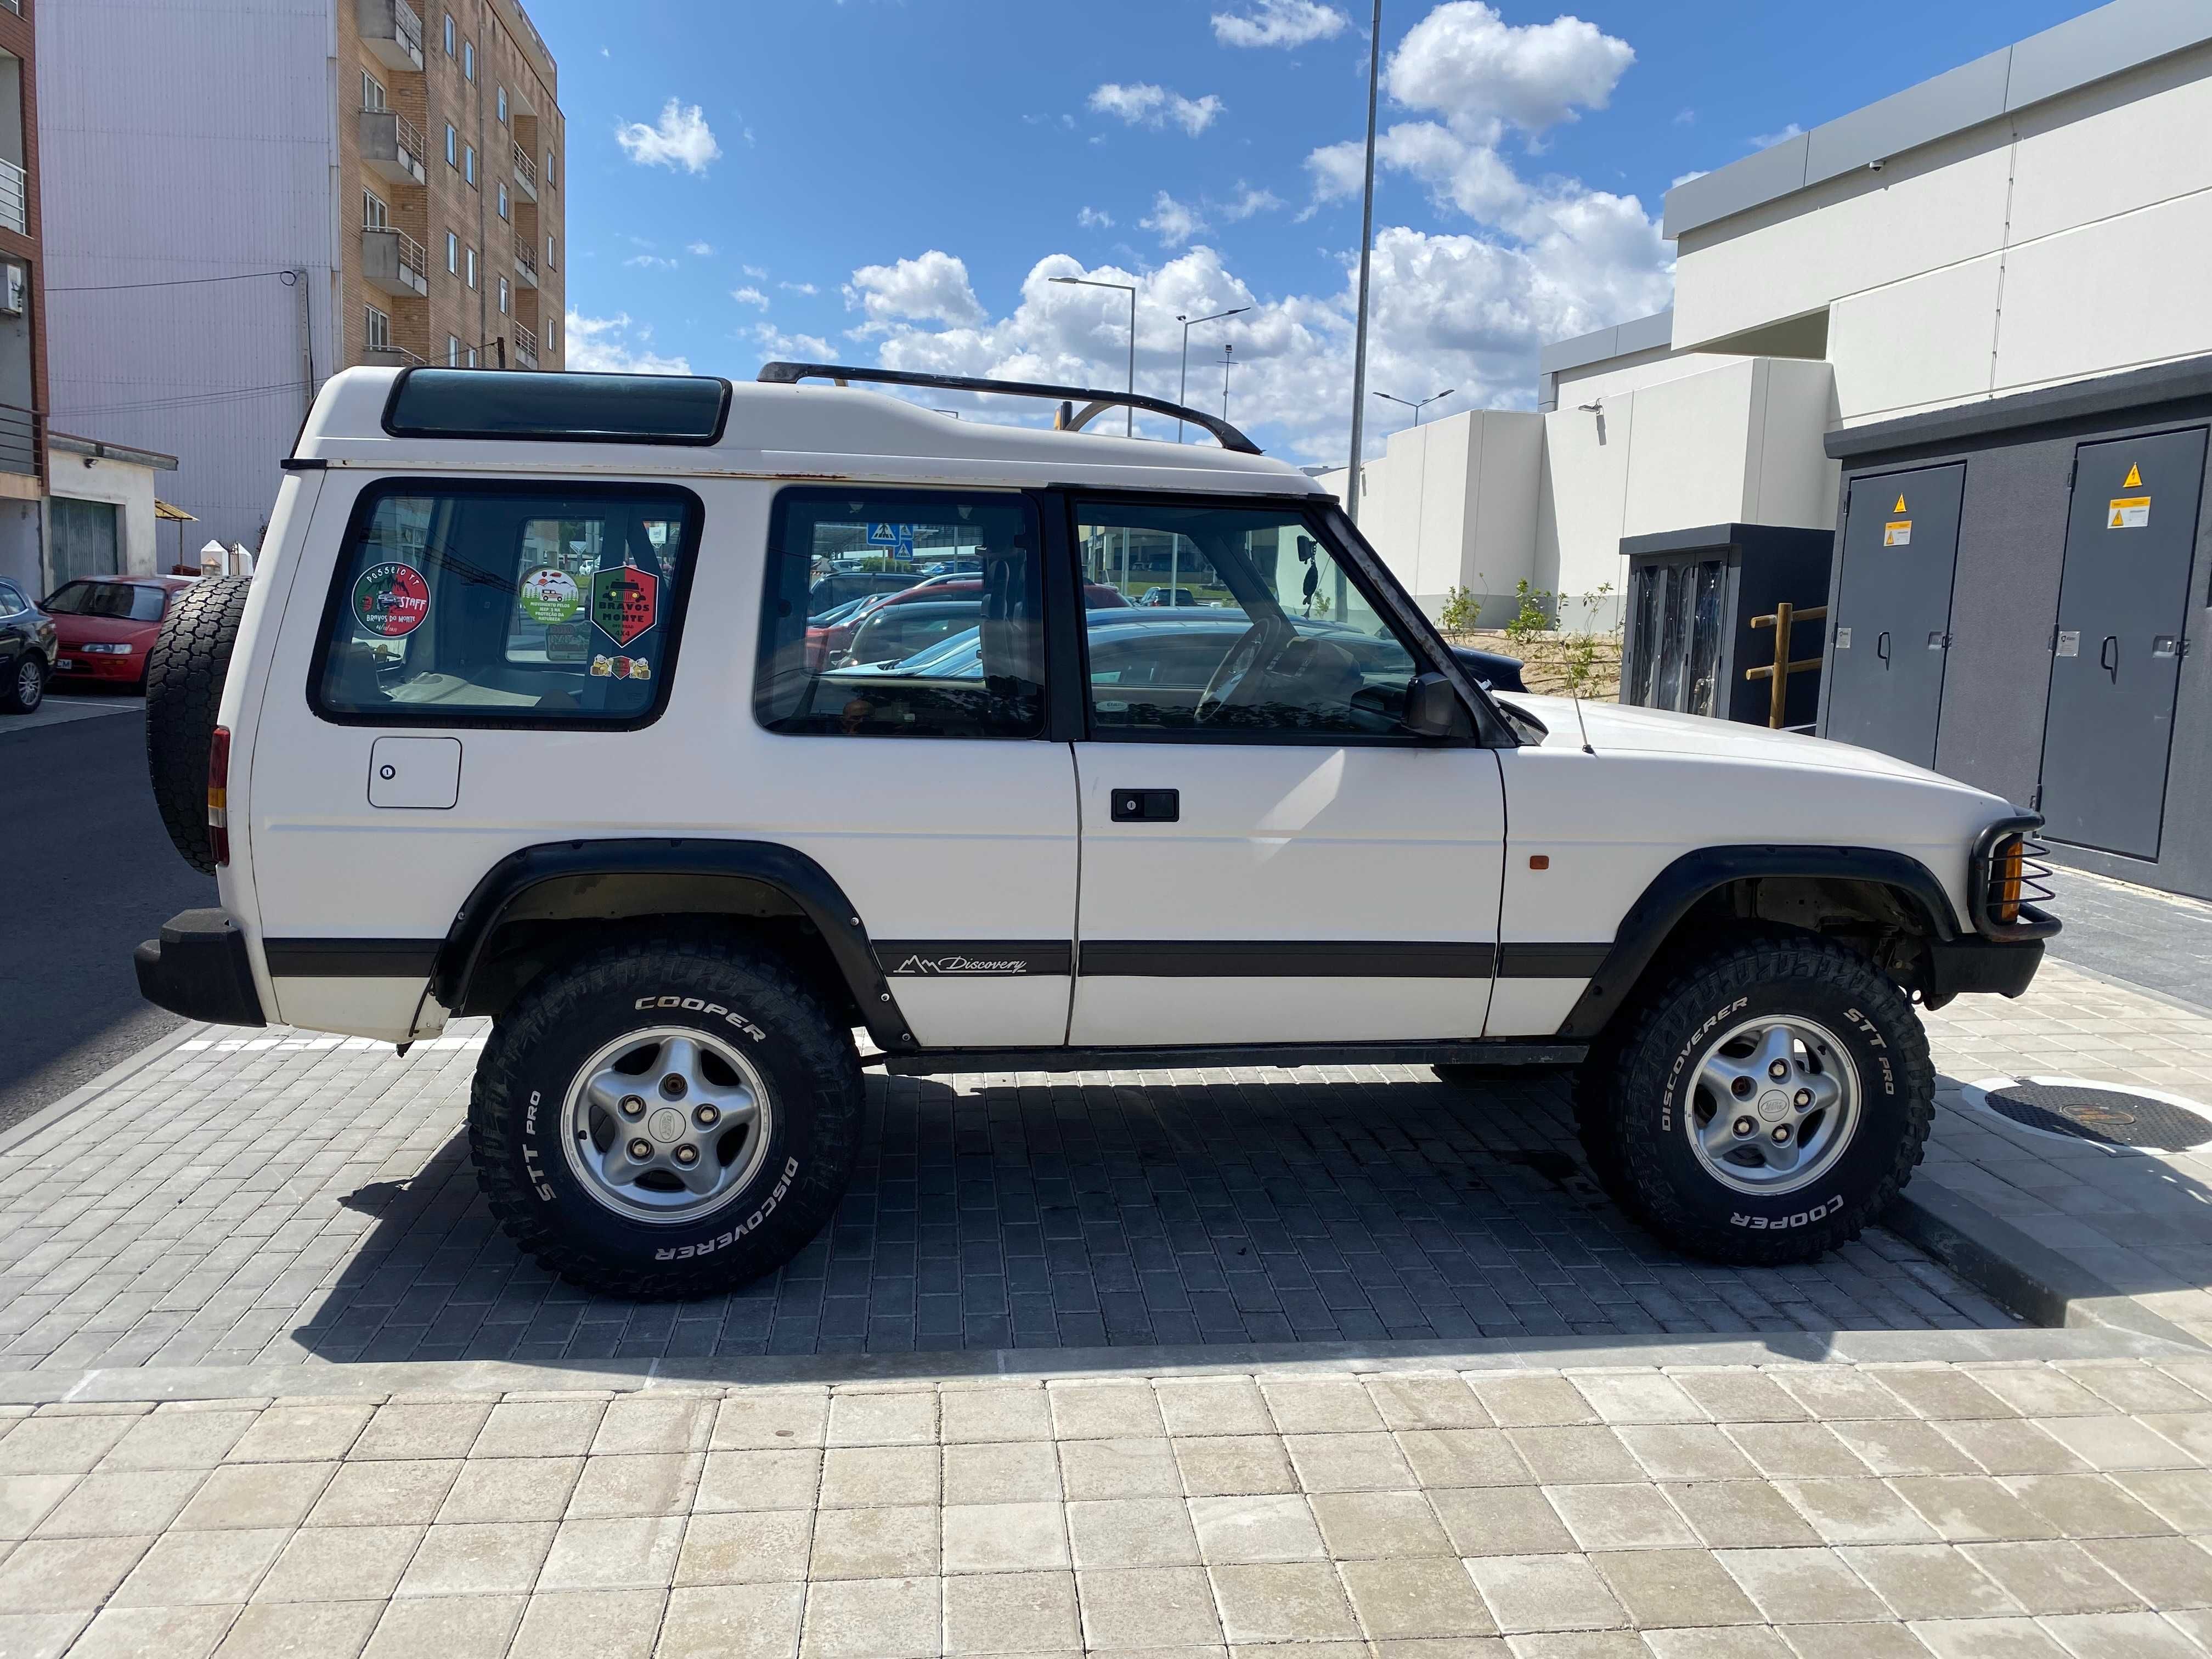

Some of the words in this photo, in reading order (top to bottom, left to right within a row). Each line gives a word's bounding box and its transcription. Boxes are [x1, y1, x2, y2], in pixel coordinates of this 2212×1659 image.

[409, 574, 420, 585] TT
[366, 614, 387, 622] BRAVOS
[399, 596, 427, 611] STAFF
[599, 602, 650, 612] BRAVOS
[603, 613, 645, 623] MONTE
[938, 956, 1027, 973] Discovery
[635, 996, 766, 1042] COOPER
[1662, 996, 1748, 1131] DISCOVERER
[1843, 1008, 1887, 1048] STT
[1878, 1057, 1894, 1095] PRO
[526, 1090, 541, 1135] PRO
[522, 1143, 557, 1201] STT
[654, 1156, 799, 1260] DISCOVERER
[1730, 1194, 1844, 1229] COOPER
